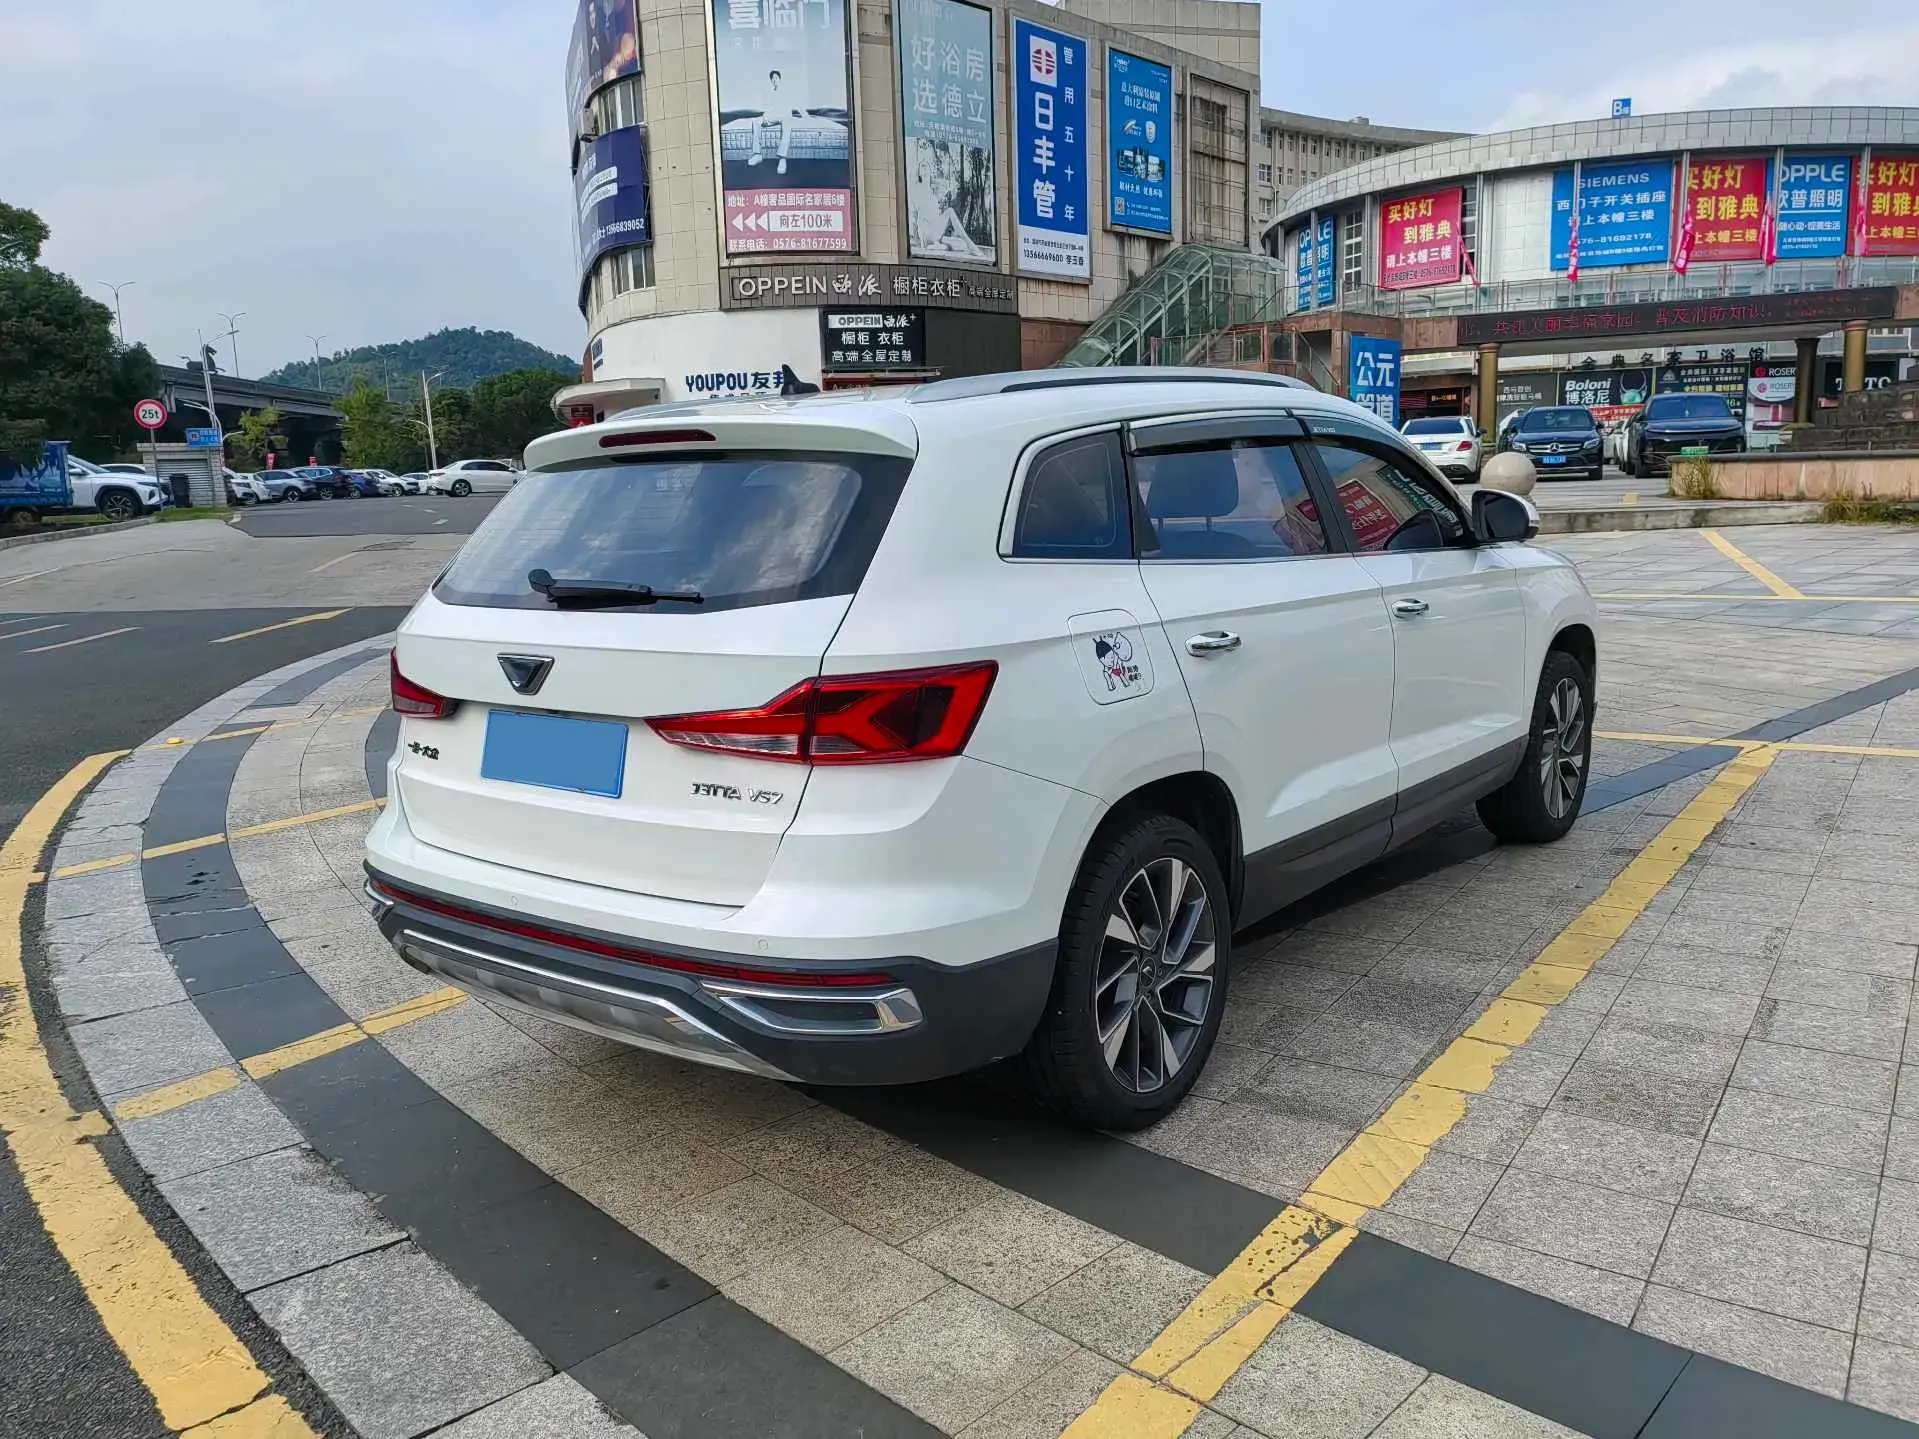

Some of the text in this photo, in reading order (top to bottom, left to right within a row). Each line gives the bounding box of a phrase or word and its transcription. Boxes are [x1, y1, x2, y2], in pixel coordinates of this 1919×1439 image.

[911, 36, 984, 82] 好浴房
[912, 79, 986, 124] 选德立
[1063, 46, 1074, 221] 管用五十年
[1033, 91, 1056, 219] 日丰管
[1578, 173, 1650, 189] SIEMENS
[1388, 198, 1436, 224] 买好灯
[1696, 194, 1759, 221] 到雅典
[780, 214, 832, 228] 向左100米
[1404, 219, 1452, 244] 到雅典
[1300, 221, 1331, 248] OPLE
[1866, 226, 1919, 239] 上本幢三
[740, 275, 827, 296] OPPEIN
[838, 316, 881, 326] OPPEIN
[841, 332, 904, 345] 橱柜 衣柜
[1356, 352, 1395, 387] 公元
[685, 372, 748, 393] YOUPOU
[1565, 378, 1612, 391] Boloni
[1835, 376, 1892, 391] TTO
[1566, 390, 1611, 405] 博洛尼
[141, 408, 160, 420] 25t
[691, 783, 784, 805] JETTA VS7
